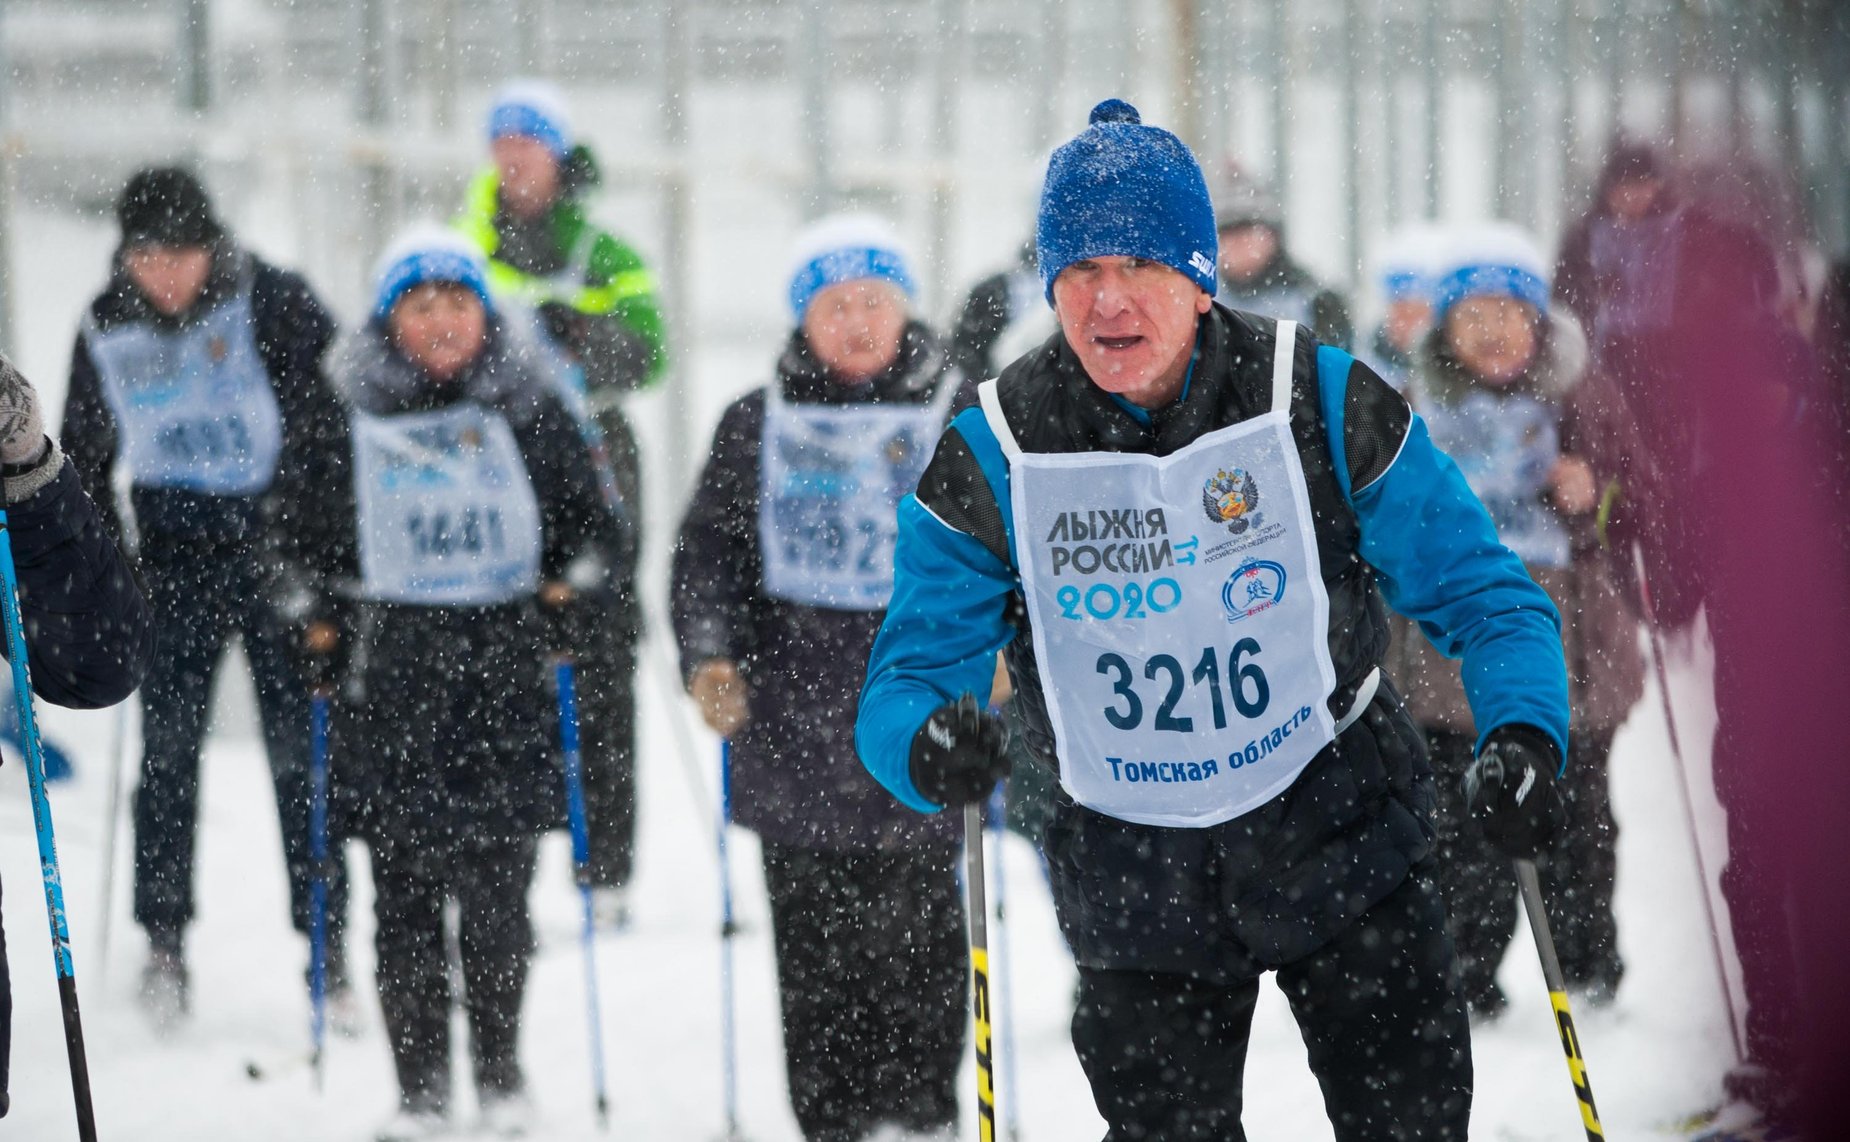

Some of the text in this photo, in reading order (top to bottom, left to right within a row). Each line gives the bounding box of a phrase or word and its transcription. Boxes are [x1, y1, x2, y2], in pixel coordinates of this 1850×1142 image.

[1047, 507, 1168, 543] ЛЫЖНЯ
[1051, 539, 1175, 577] РОССИИ
[1056, 577, 1182, 621] 2020
[1096, 636, 1271, 733] 3216
[1106, 704, 1312, 783] Томская область
